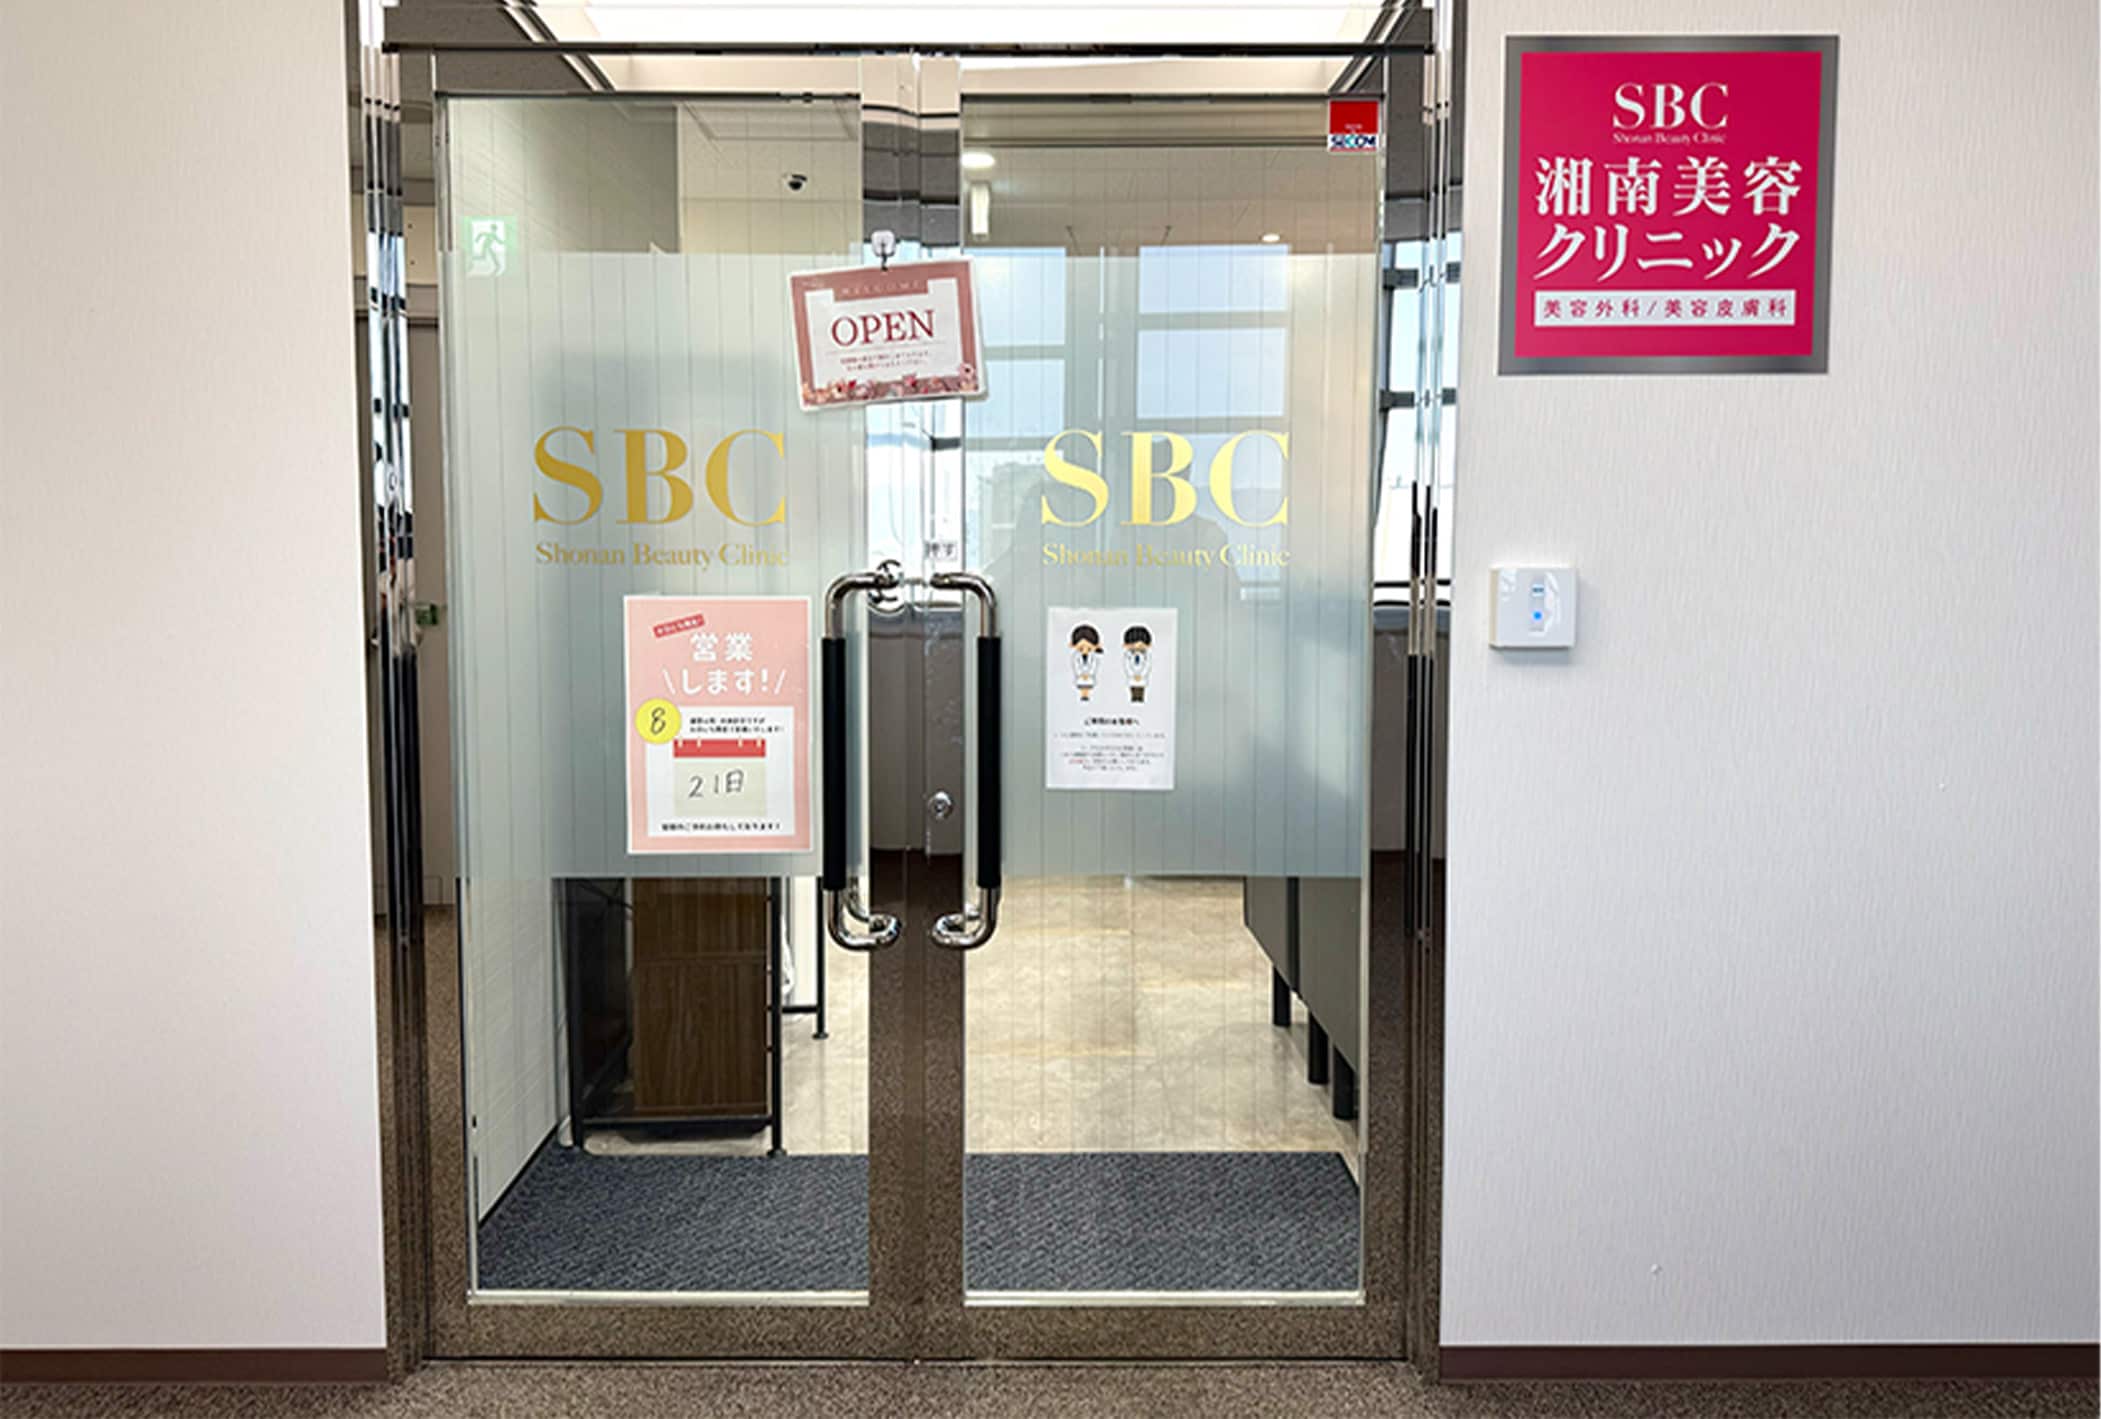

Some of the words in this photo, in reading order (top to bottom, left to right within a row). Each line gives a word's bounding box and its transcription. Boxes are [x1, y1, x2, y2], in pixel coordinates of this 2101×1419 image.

[1613, 82, 1729, 130] SBC
[1613, 132, 1652, 143] Shonan
[1655, 132, 1690, 146] Beauty
[1693, 132, 1727, 144] Clinic
[1534, 156, 1803, 216] 湘南美容
[1533, 222, 1801, 282] クリニック
[1543, 298, 1788, 318] 美容外科/美容皮膚科
[831, 309, 935, 347] OPEN
[533, 425, 786, 528] SBC
[1041, 428, 1290, 528] SBC
[535, 541, 625, 566] Shonan
[632, 542, 714, 572] Beauty
[718, 542, 790, 567] Clinic
[1042, 542, 1129, 567] Shonan
[1135, 542, 1215, 571] Beauty
[1218, 542, 1291, 567] Clinic
[690, 632, 753, 661] 営業
[650, 706, 667, 735] 8
